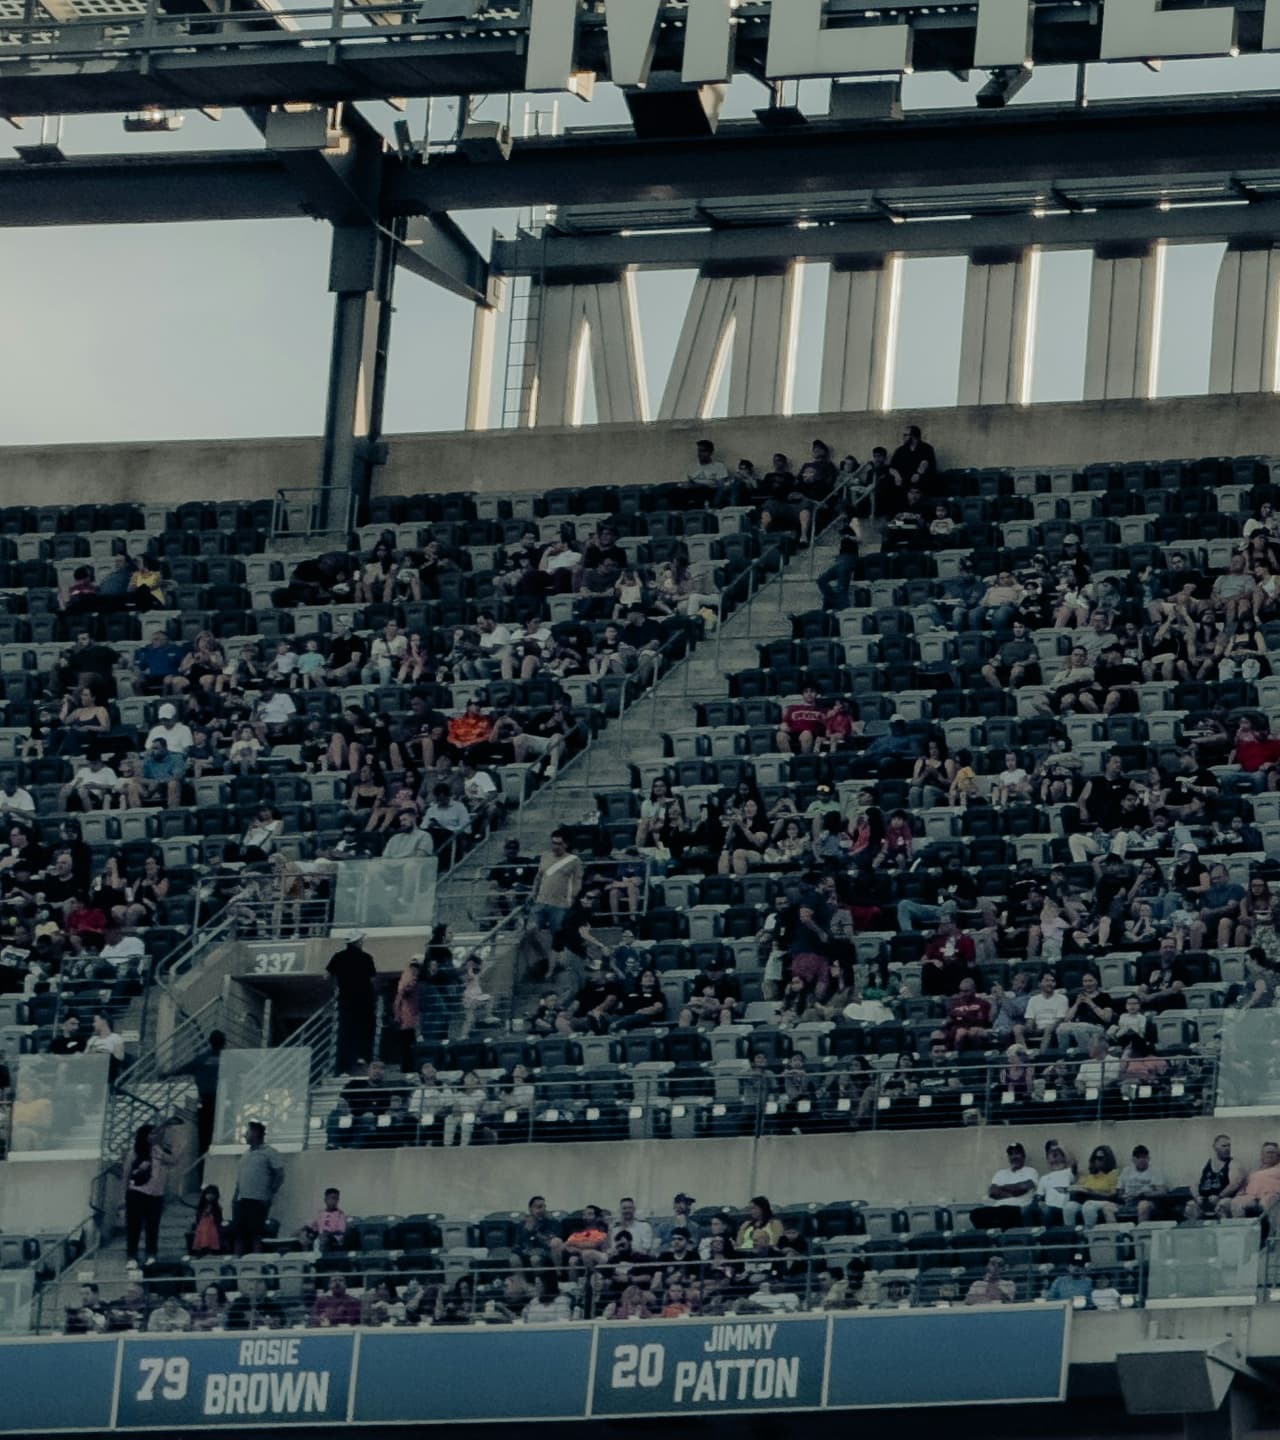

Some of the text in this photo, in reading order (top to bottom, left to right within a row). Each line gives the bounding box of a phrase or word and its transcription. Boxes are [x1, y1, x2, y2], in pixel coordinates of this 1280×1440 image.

[255, 952, 296, 973] 337
[239, 1338, 300, 1366] ROSIE
[704, 1323, 777, 1352] JIMMY
[136, 1358, 189, 1401] 79
[611, 1344, 665, 1388] 20
[673, 1357, 800, 1403] PATTON
[203, 1371, 330, 1415] BROWN
